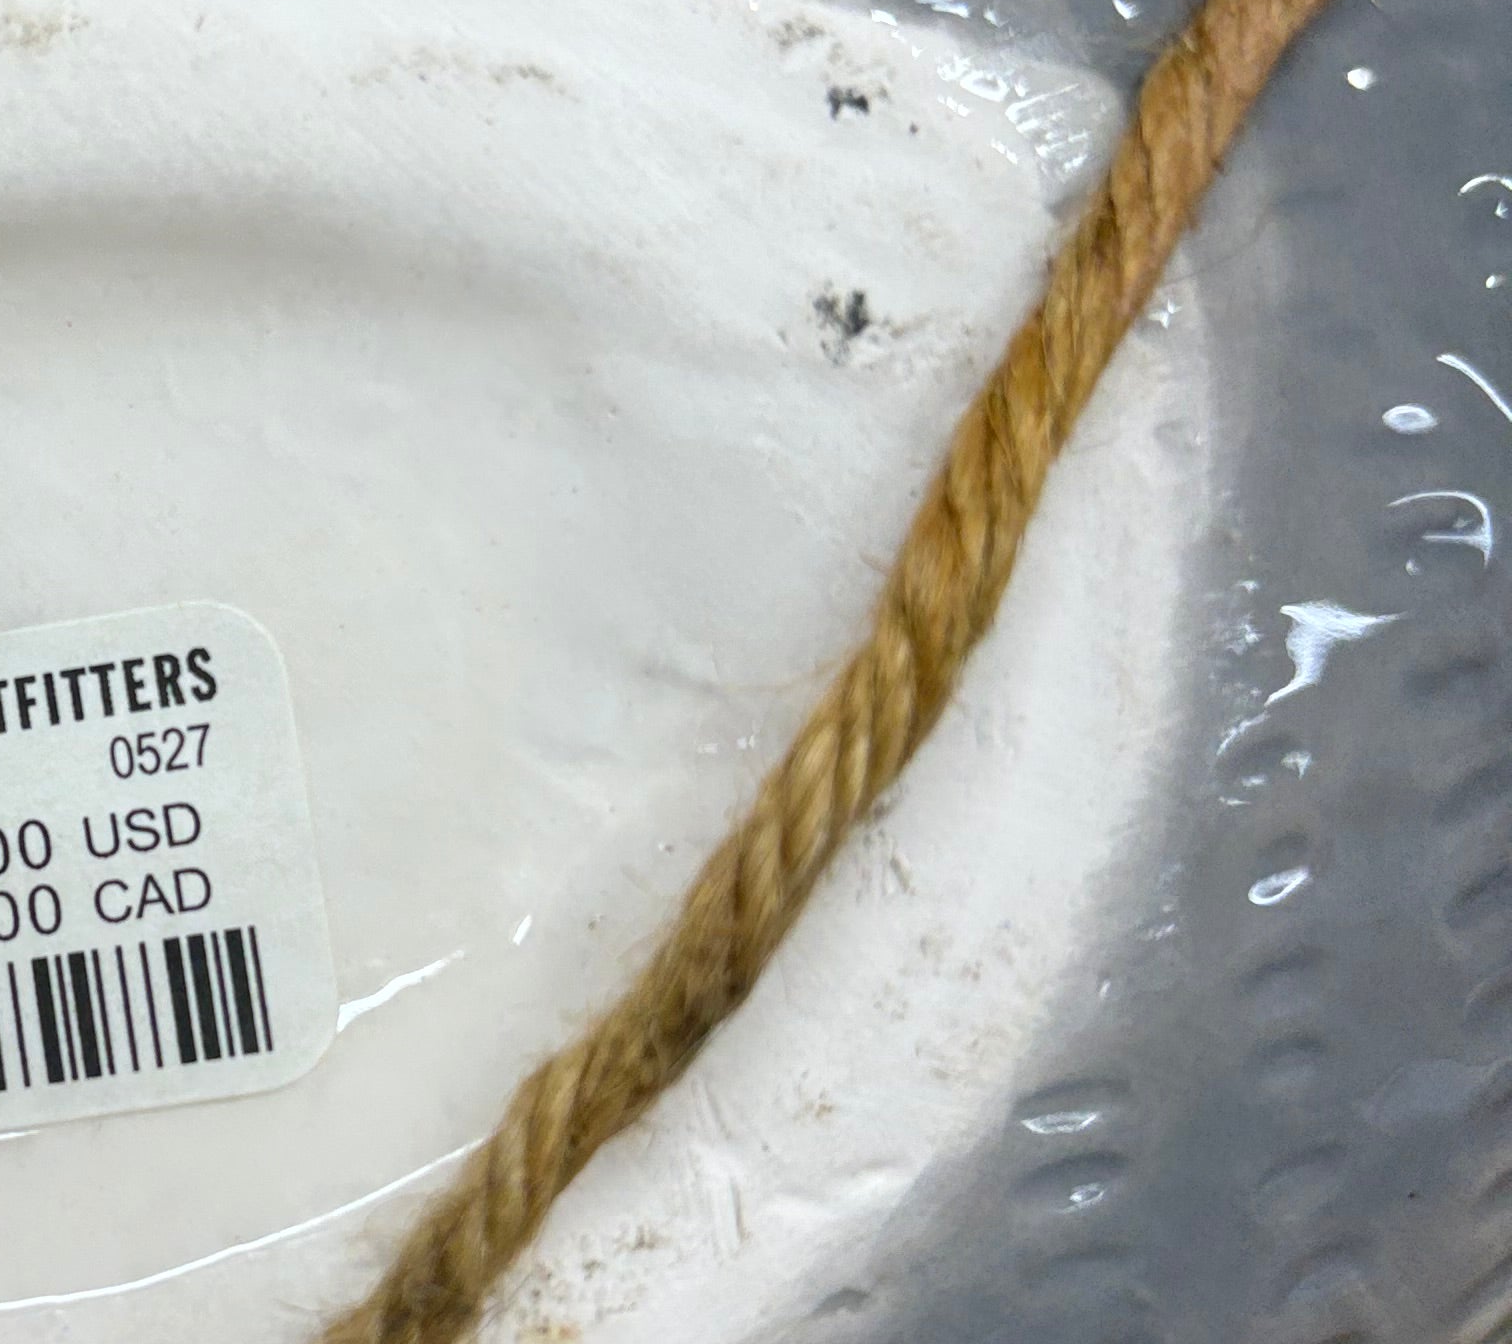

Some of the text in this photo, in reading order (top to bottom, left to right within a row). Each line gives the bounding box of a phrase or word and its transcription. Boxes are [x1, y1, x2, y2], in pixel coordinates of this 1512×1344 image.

[109, 723, 210, 780] 0527
[82, 802, 202, 859] USD
[93, 867, 212, 924] CAD
